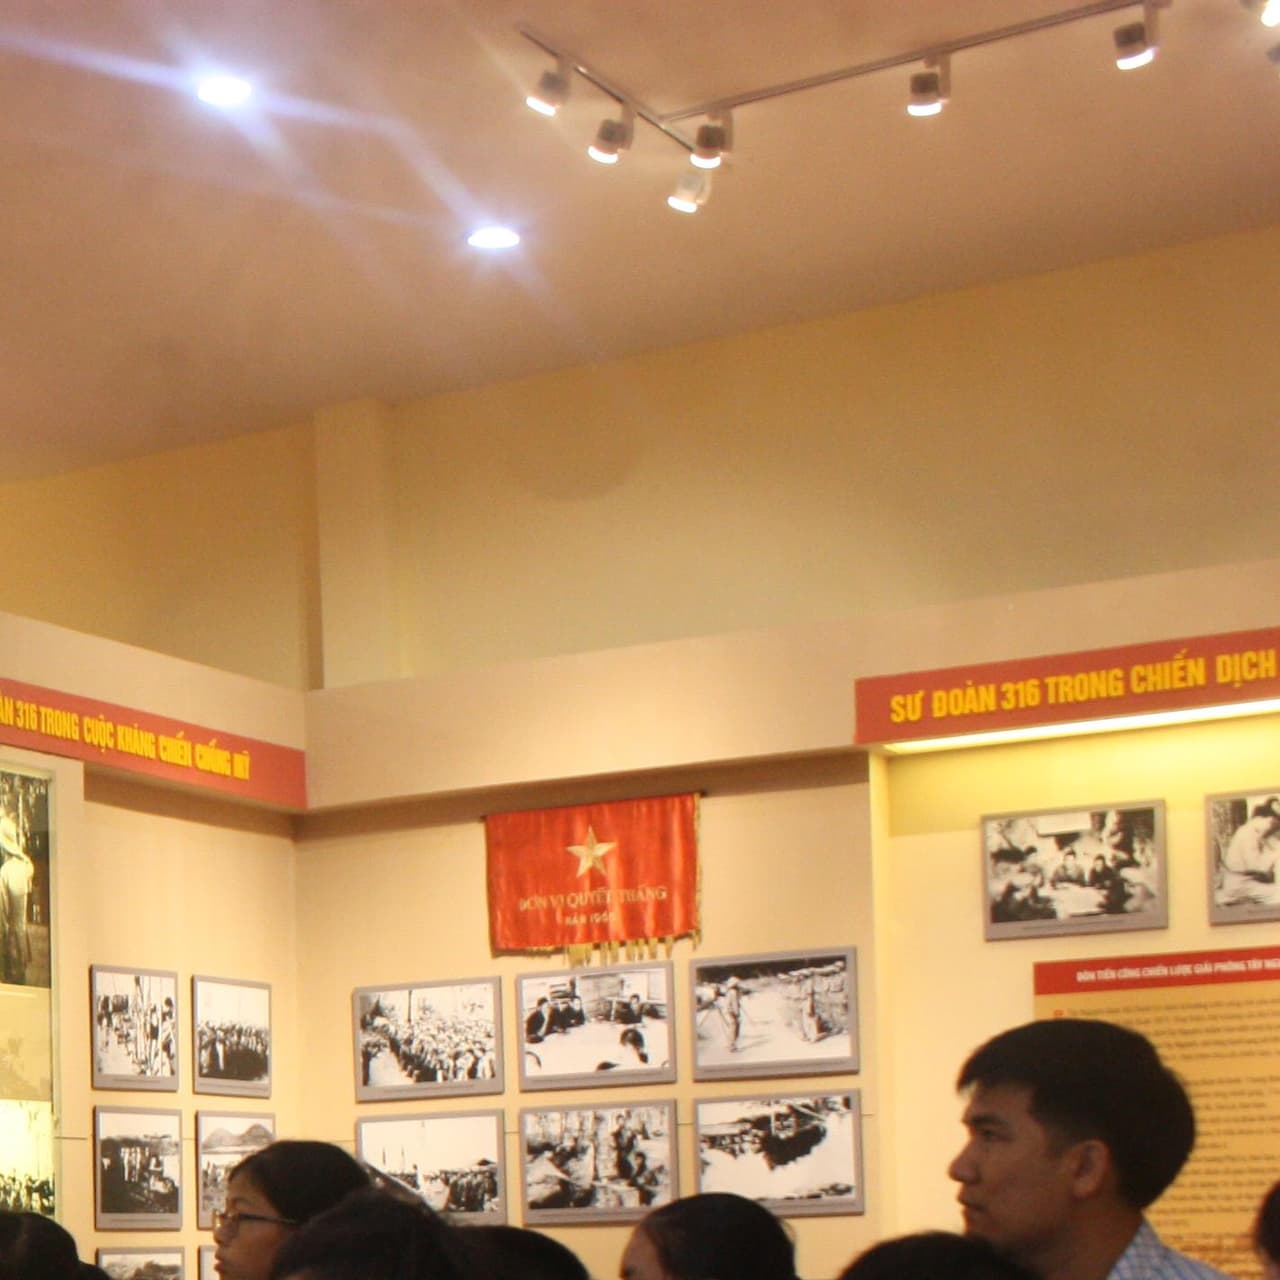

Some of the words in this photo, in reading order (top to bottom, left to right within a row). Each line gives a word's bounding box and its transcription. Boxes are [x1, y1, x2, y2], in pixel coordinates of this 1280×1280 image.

[890, 690, 924, 723] SƯ
[931, 679, 997, 719] ĐOÀN
[1000, 678, 1041, 711] 316
[1044, 667, 1124, 704] TRONG
[1130, 647, 1207, 694] CHIẾN
[1215, 648, 1278, 689] DỊCH
[15, 700, 38, 731] 316
[39, 705, 80, 741] TRONG
[83, 714, 114, 753] CUỘC
[116, 723, 156, 759] KHÁNG
[158, 730, 192, 767] CHIẾN
